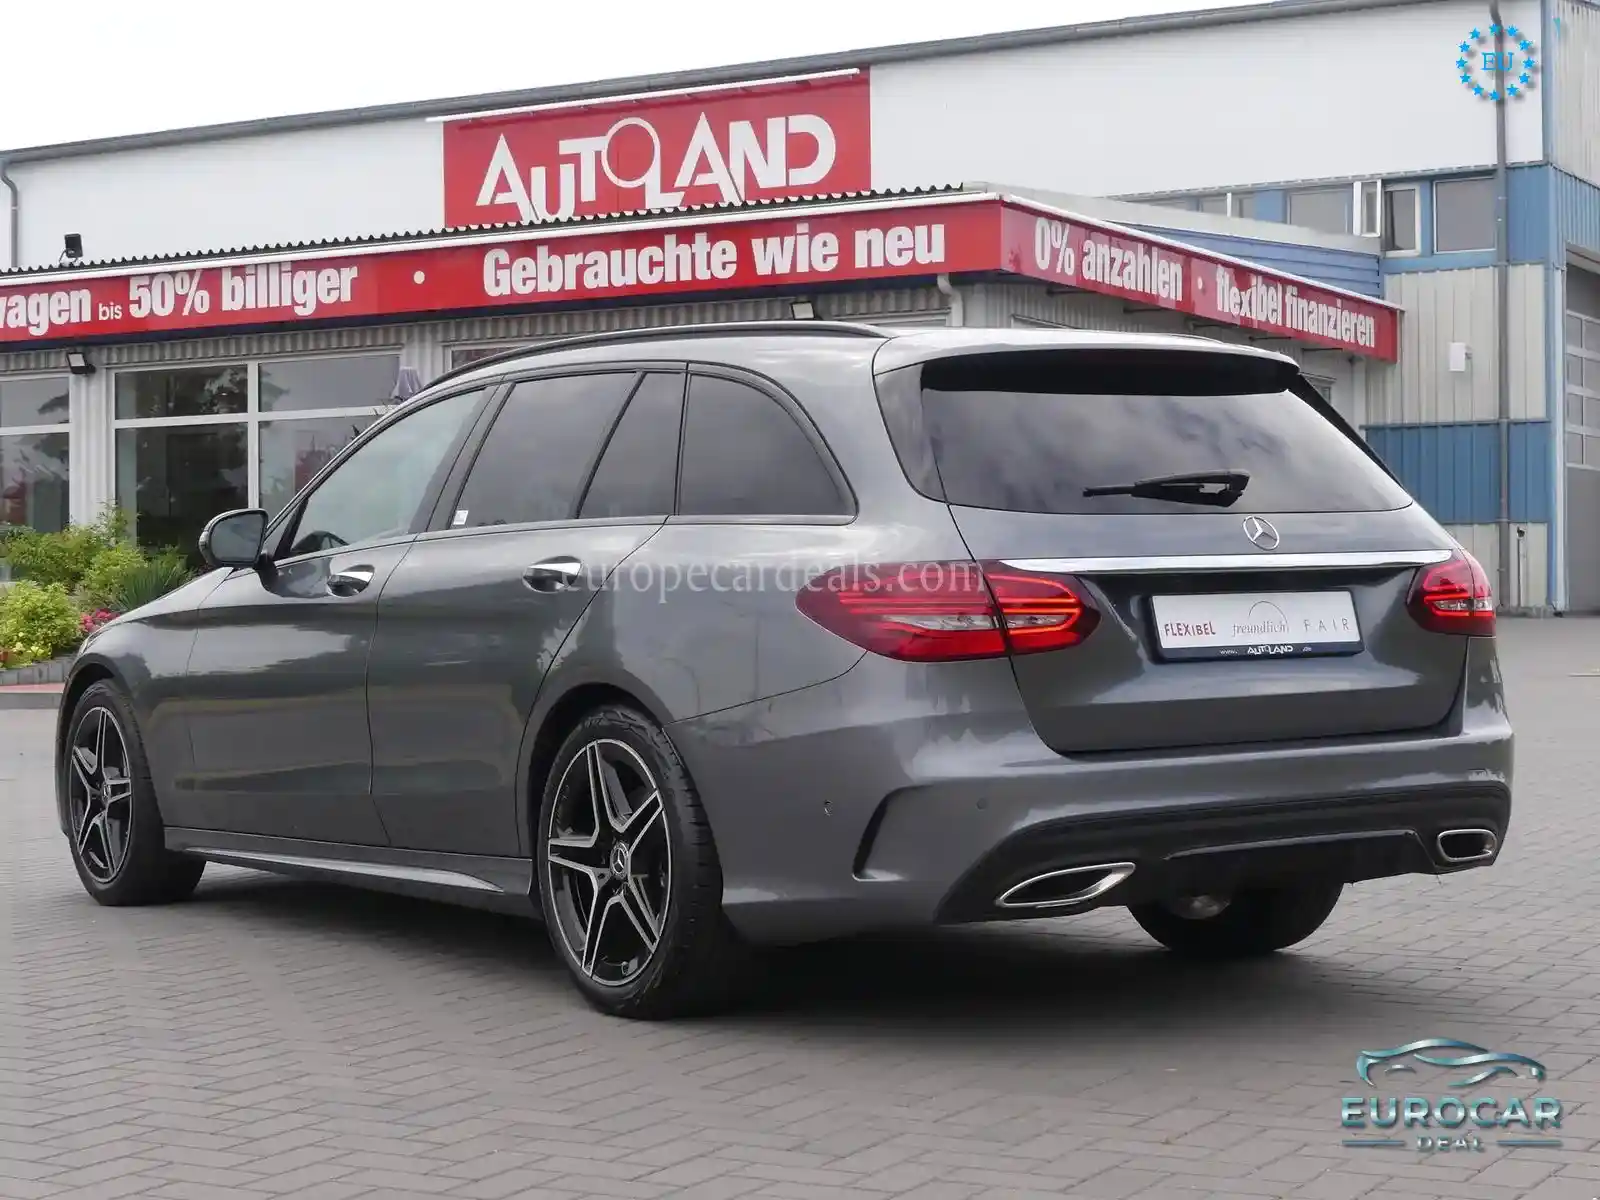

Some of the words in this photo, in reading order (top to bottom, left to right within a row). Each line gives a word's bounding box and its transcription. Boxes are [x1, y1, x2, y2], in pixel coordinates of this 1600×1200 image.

[0, 288, 92, 336] agen
[98, 301, 123, 321] bis
[129, 270, 210, 319] 50%
[221, 262, 359, 316] billiger
[483, 232, 738, 297] Gebrauchte
[752, 223, 839, 276] wie
[854, 223, 946, 268] neu
[1034, 216, 1075, 277] 0%
[1081, 237, 1183, 302] anzahlen
[1216, 263, 1283, 327] flexibel
[1285, 284, 1375, 349] finanzieren
[1164, 621, 1216, 637] FLEXIBEL
